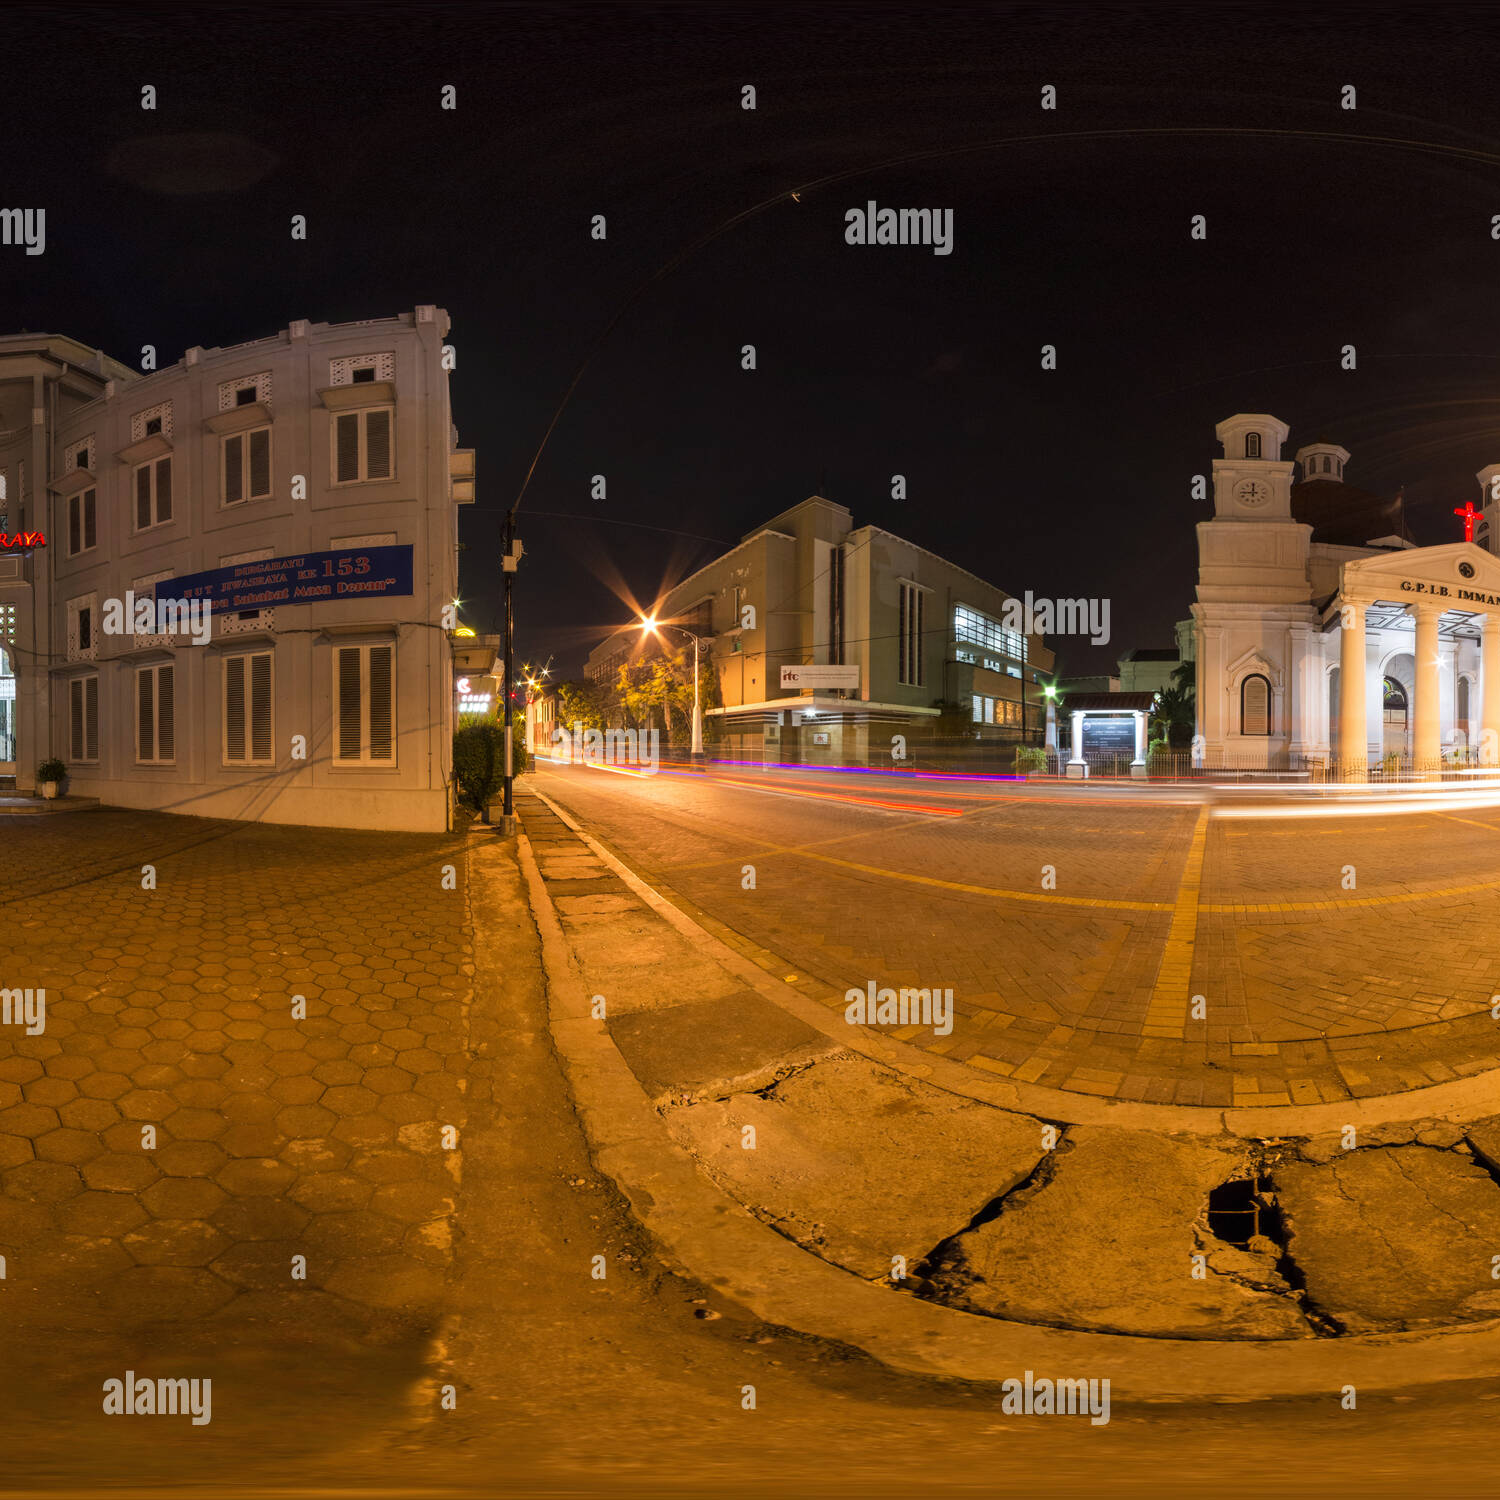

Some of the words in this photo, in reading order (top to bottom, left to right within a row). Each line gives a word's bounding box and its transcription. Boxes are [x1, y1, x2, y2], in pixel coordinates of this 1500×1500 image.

[322, 556, 371, 577] 153
[294, 585, 331, 598] Masa
[1400, 581, 1452, 597] G.P.I.B.
